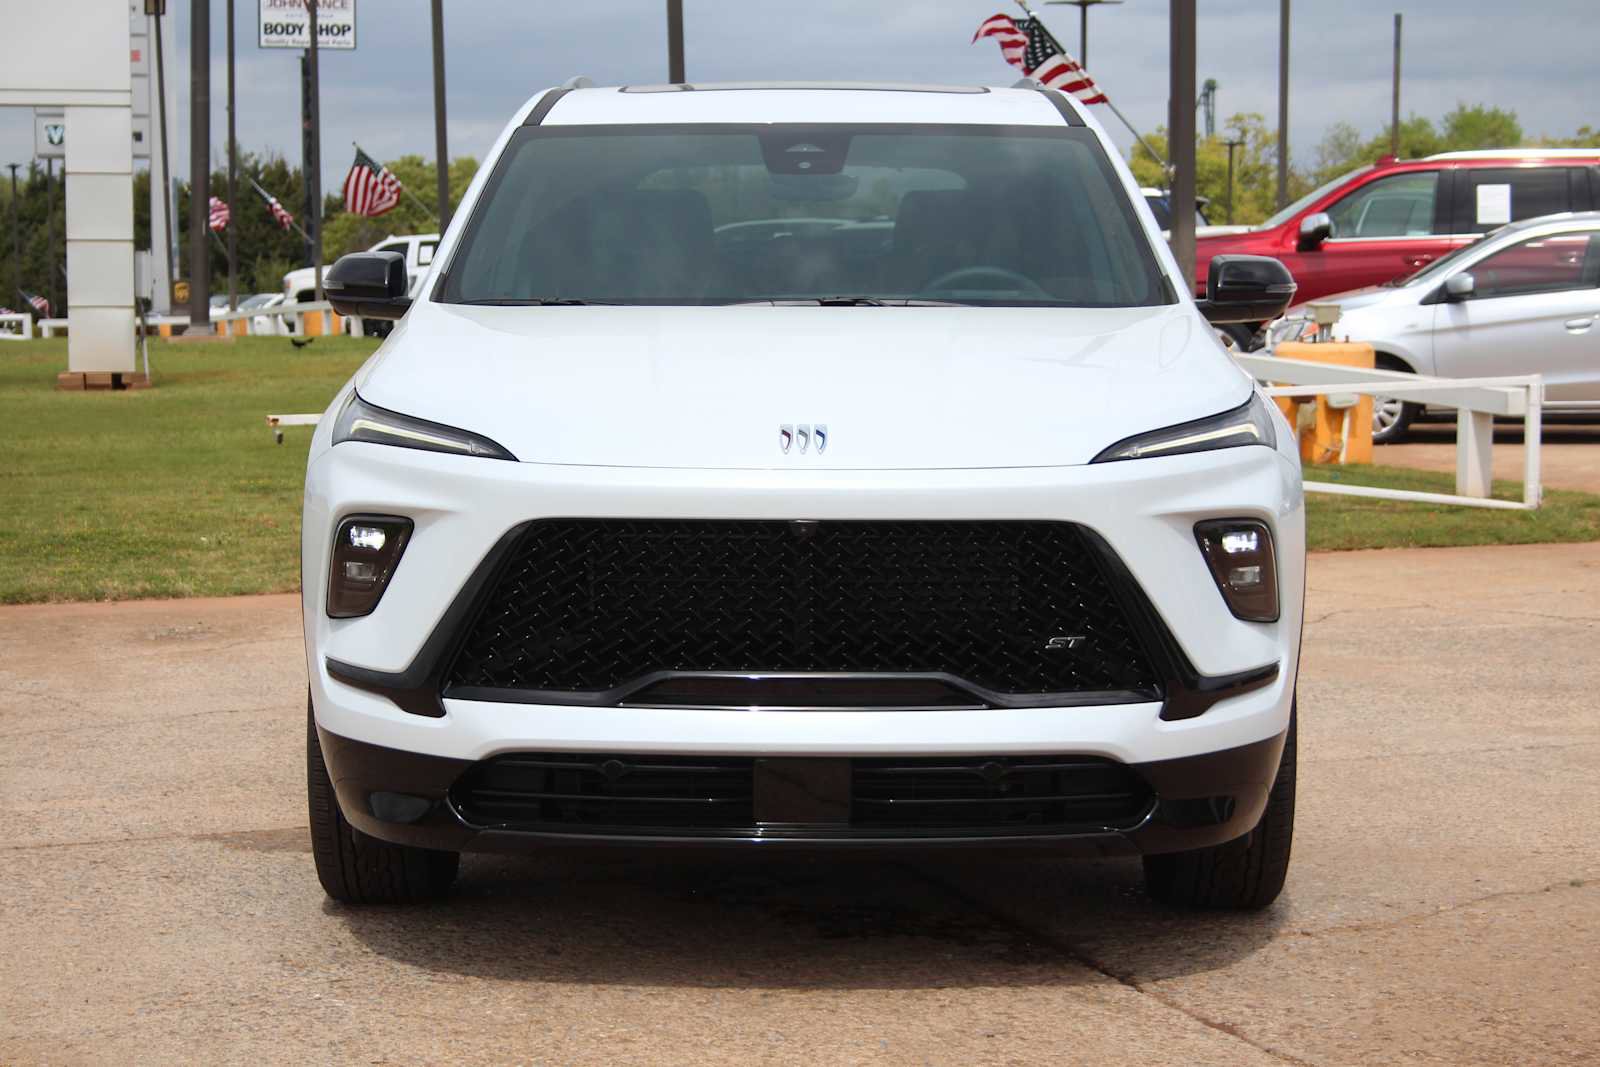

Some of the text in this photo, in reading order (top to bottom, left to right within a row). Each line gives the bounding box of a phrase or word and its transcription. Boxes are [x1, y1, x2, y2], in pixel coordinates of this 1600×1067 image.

[267, 0, 303, 9] JOHN
[263, 23, 352, 37] BODY HOP
[1044, 636, 1086, 649] ST
